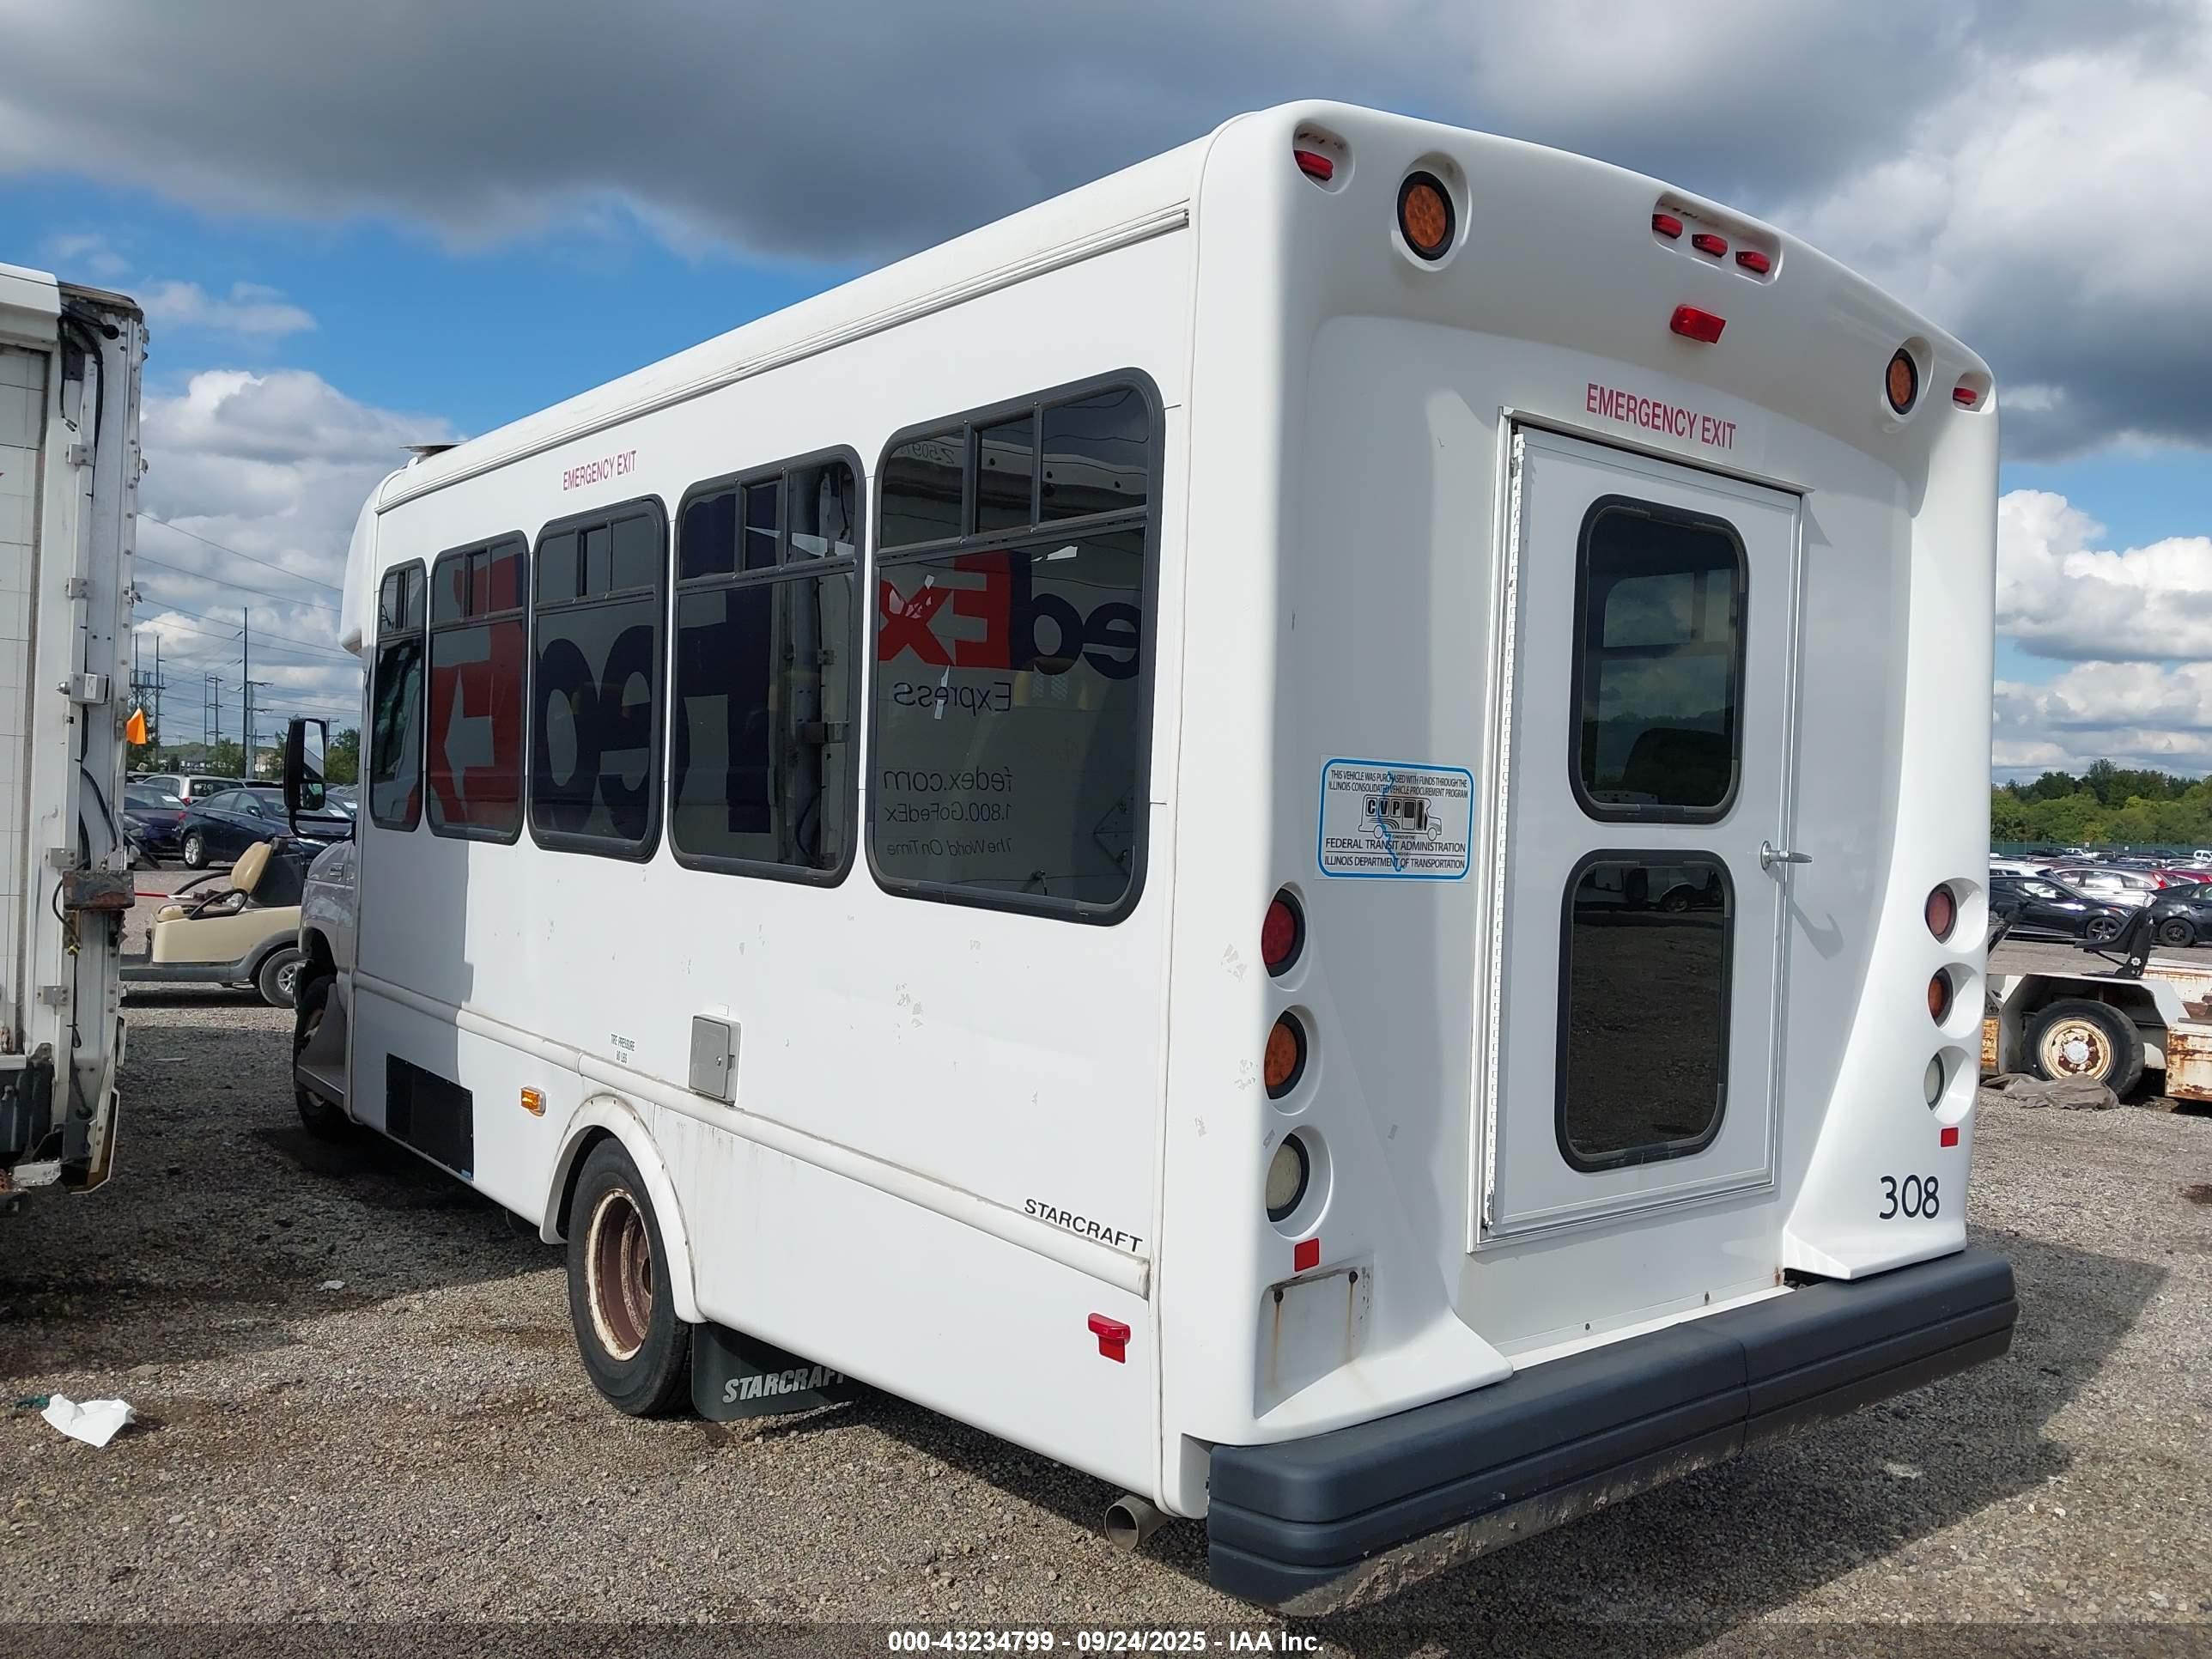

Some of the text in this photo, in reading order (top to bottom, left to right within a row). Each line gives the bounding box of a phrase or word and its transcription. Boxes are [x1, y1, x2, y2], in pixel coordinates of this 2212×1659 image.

[1586, 383, 1736, 450] EMERGENCY EXIT
[563, 450, 636, 491] EMERGENCY EXIT
[1330, 769, 1468, 787] THIS VEHICLE WAS PURCHASED WITH FUNDS THROUGH THE
[1328, 781, 1468, 799] ILLINOIS CONSOLIDATED VEHICLE PROCUREMENT PROGRAM
[1368, 799, 1400, 816] CVP
[1326, 838, 1466, 853] FEDERAL TRANSIT ADMINISTRATION
[1325, 855, 1465, 869] ILLINOIS DEPARTMENT OF TRANSPORTATION
[1879, 1174, 1940, 1219] 308
[1024, 1199, 1143, 1253] STARCRAFT
